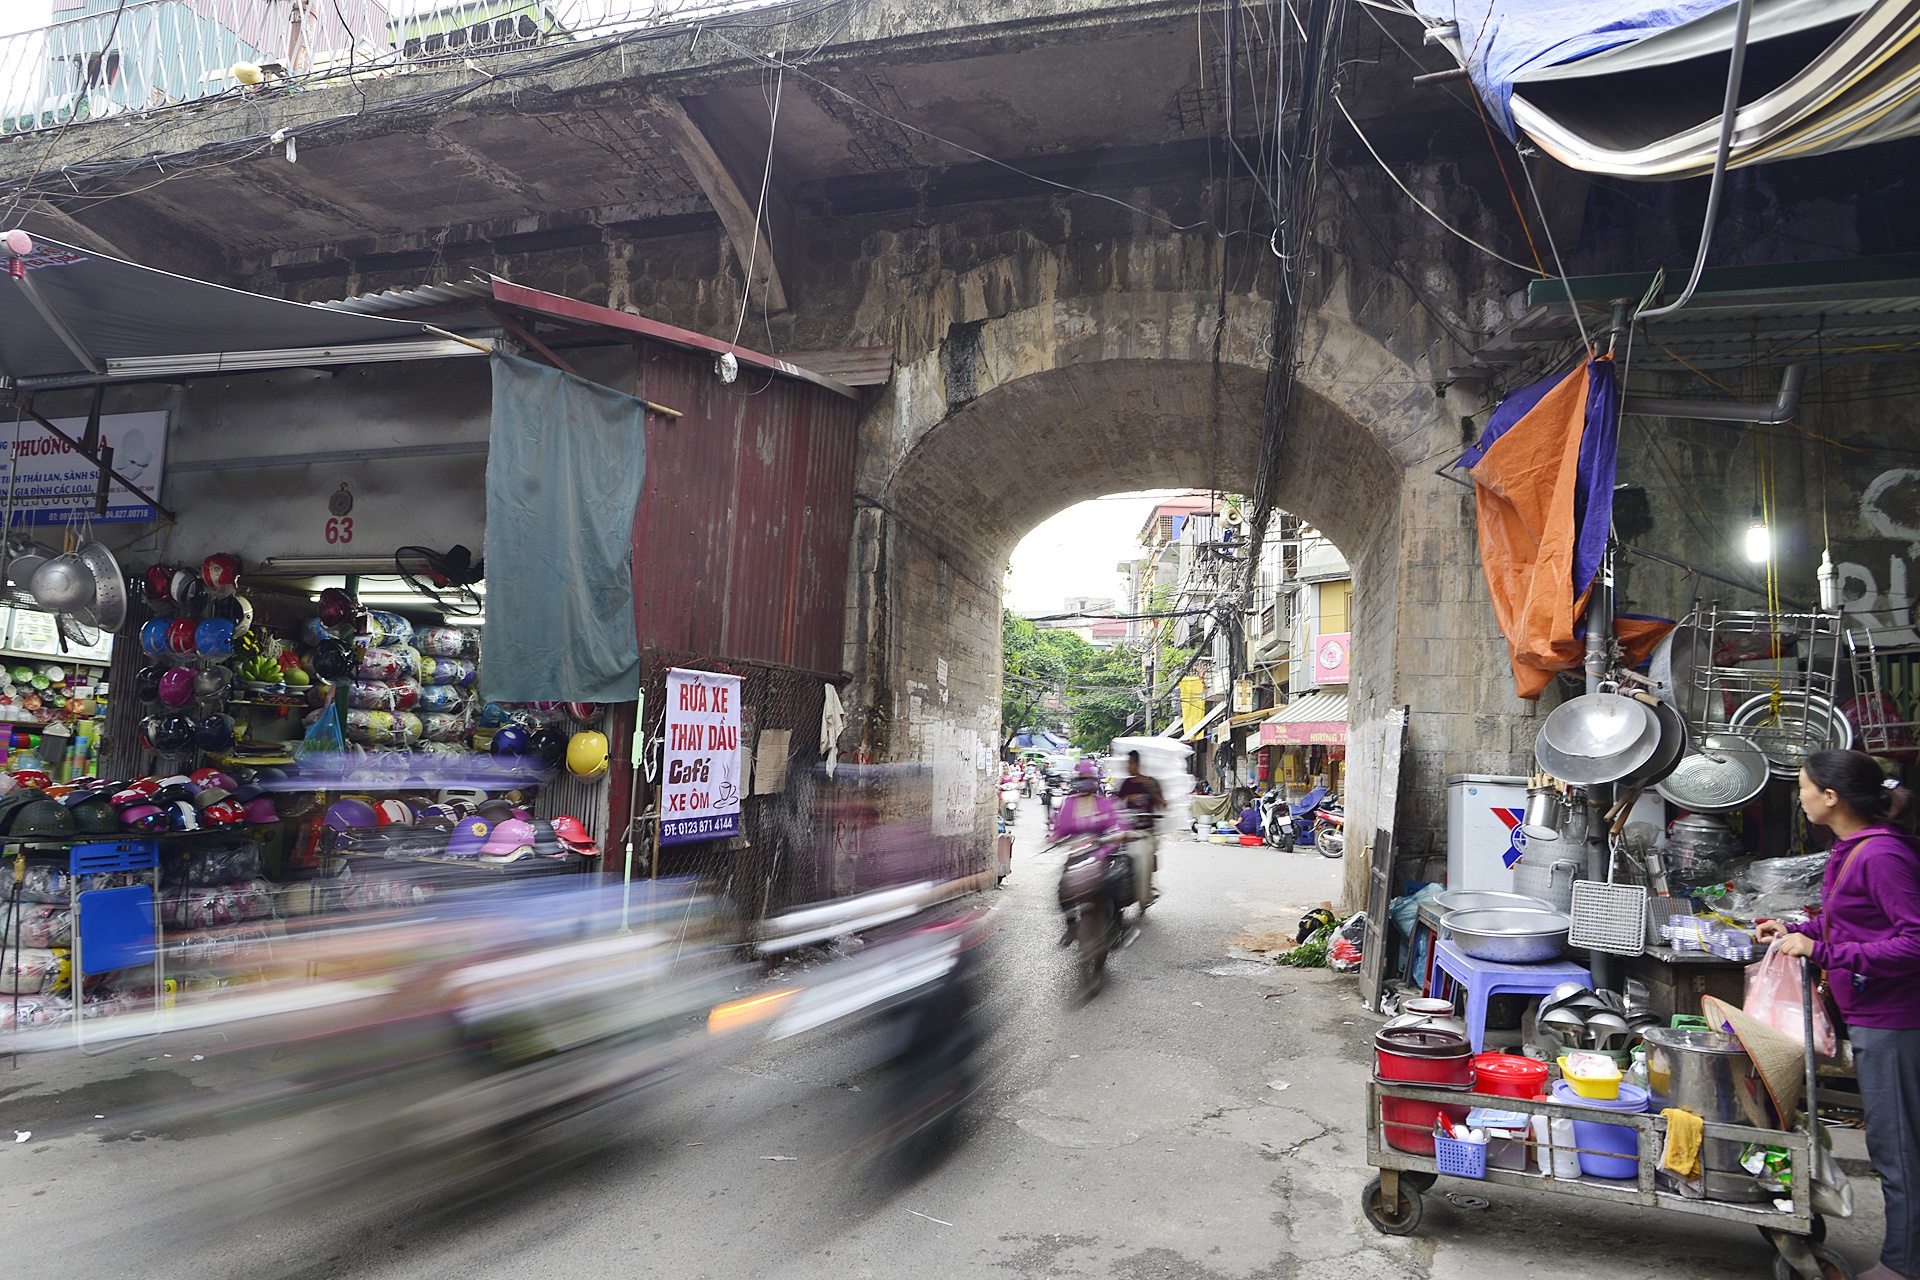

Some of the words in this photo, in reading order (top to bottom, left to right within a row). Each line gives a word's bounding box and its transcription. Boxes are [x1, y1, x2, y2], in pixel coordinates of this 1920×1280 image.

[325, 517, 353, 544] 63
[680, 676, 707, 712] RỬA
[711, 687, 728, 713] XE
[671, 723, 704, 751] THAY
[708, 716, 737, 751] DẦU
[1310, 732, 1338, 742] HƯƠNG
[668, 757, 711, 784] Café
[669, 793, 687, 812] XE
[690, 787, 709, 810] ÔM
[664, 823, 677, 837] ĐT:
[678, 821, 698, 835] 0123
[699, 820, 713, 834] 871
[714, 817, 733, 831] 4144
